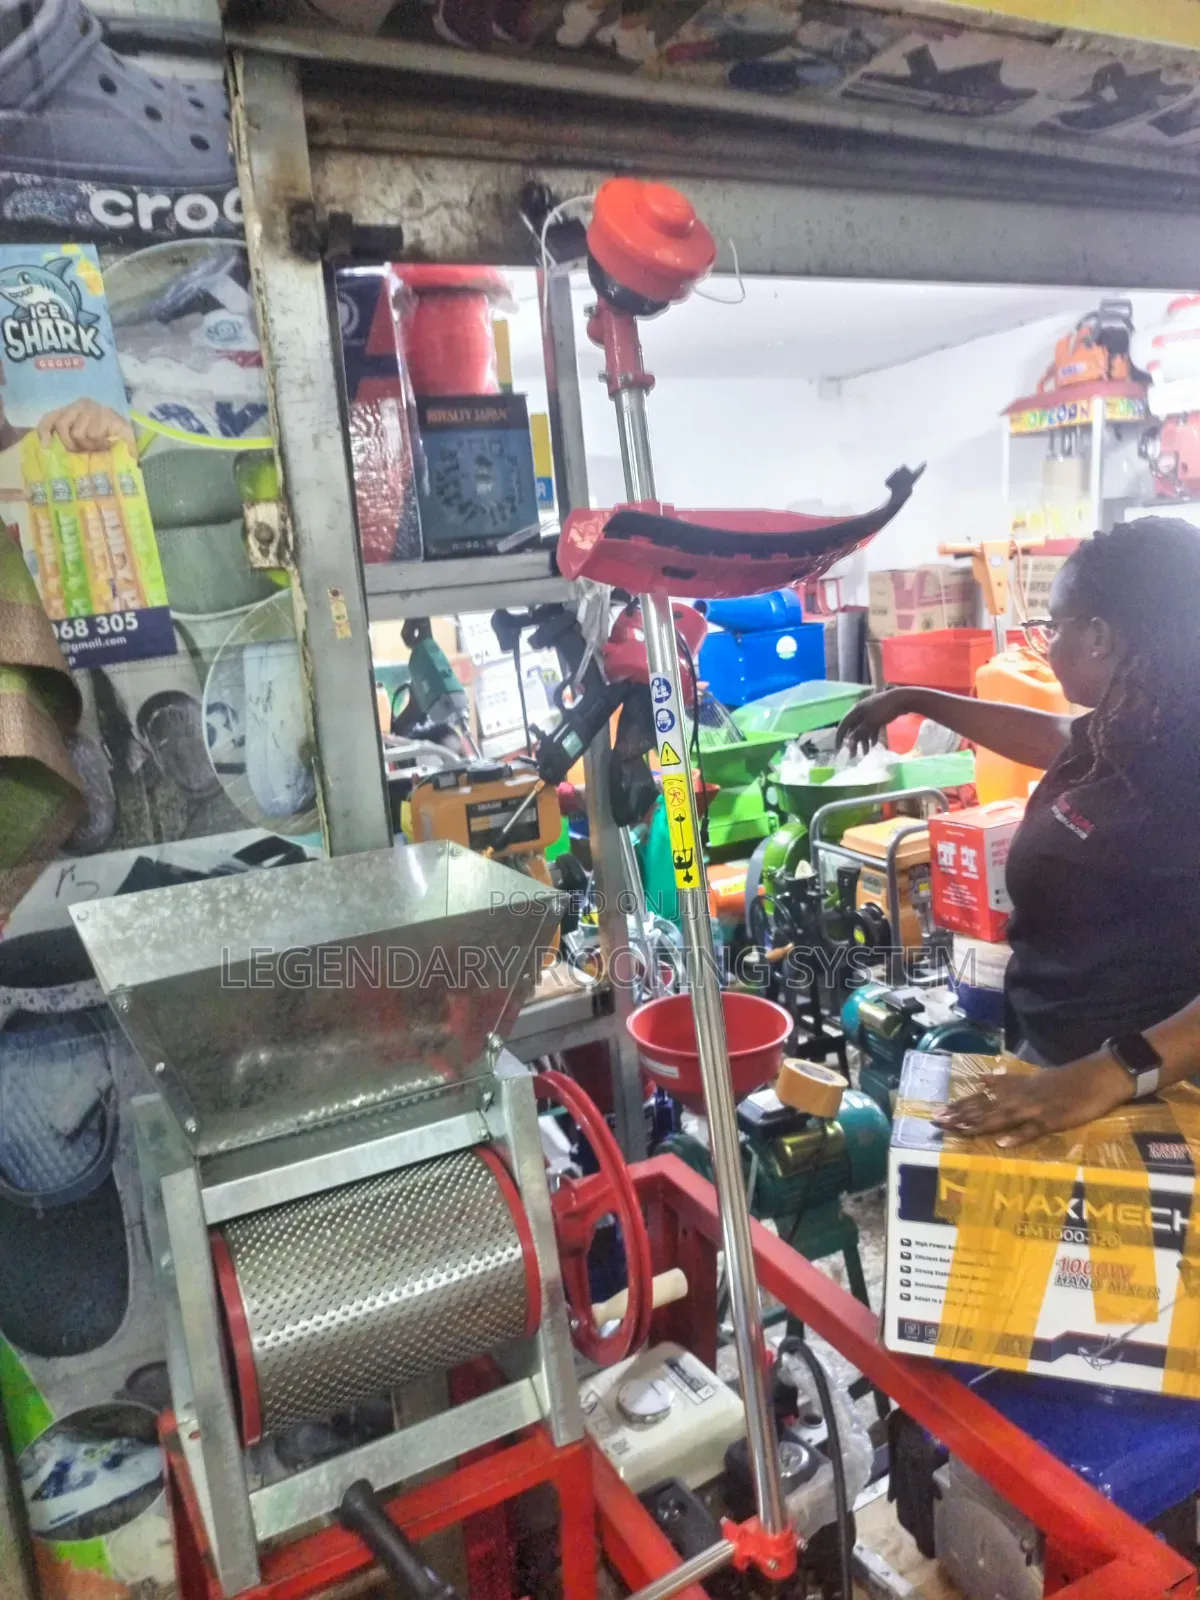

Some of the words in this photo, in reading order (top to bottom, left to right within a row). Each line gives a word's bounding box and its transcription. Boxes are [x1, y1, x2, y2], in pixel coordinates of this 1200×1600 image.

[29, 302, 61, 319] ICE
[4, 317, 104, 360] SHARK
[38, 358, 80, 369] GROUP
[96, 612, 138, 634] 305
[994, 1188, 1200, 1234] MAXMECH
